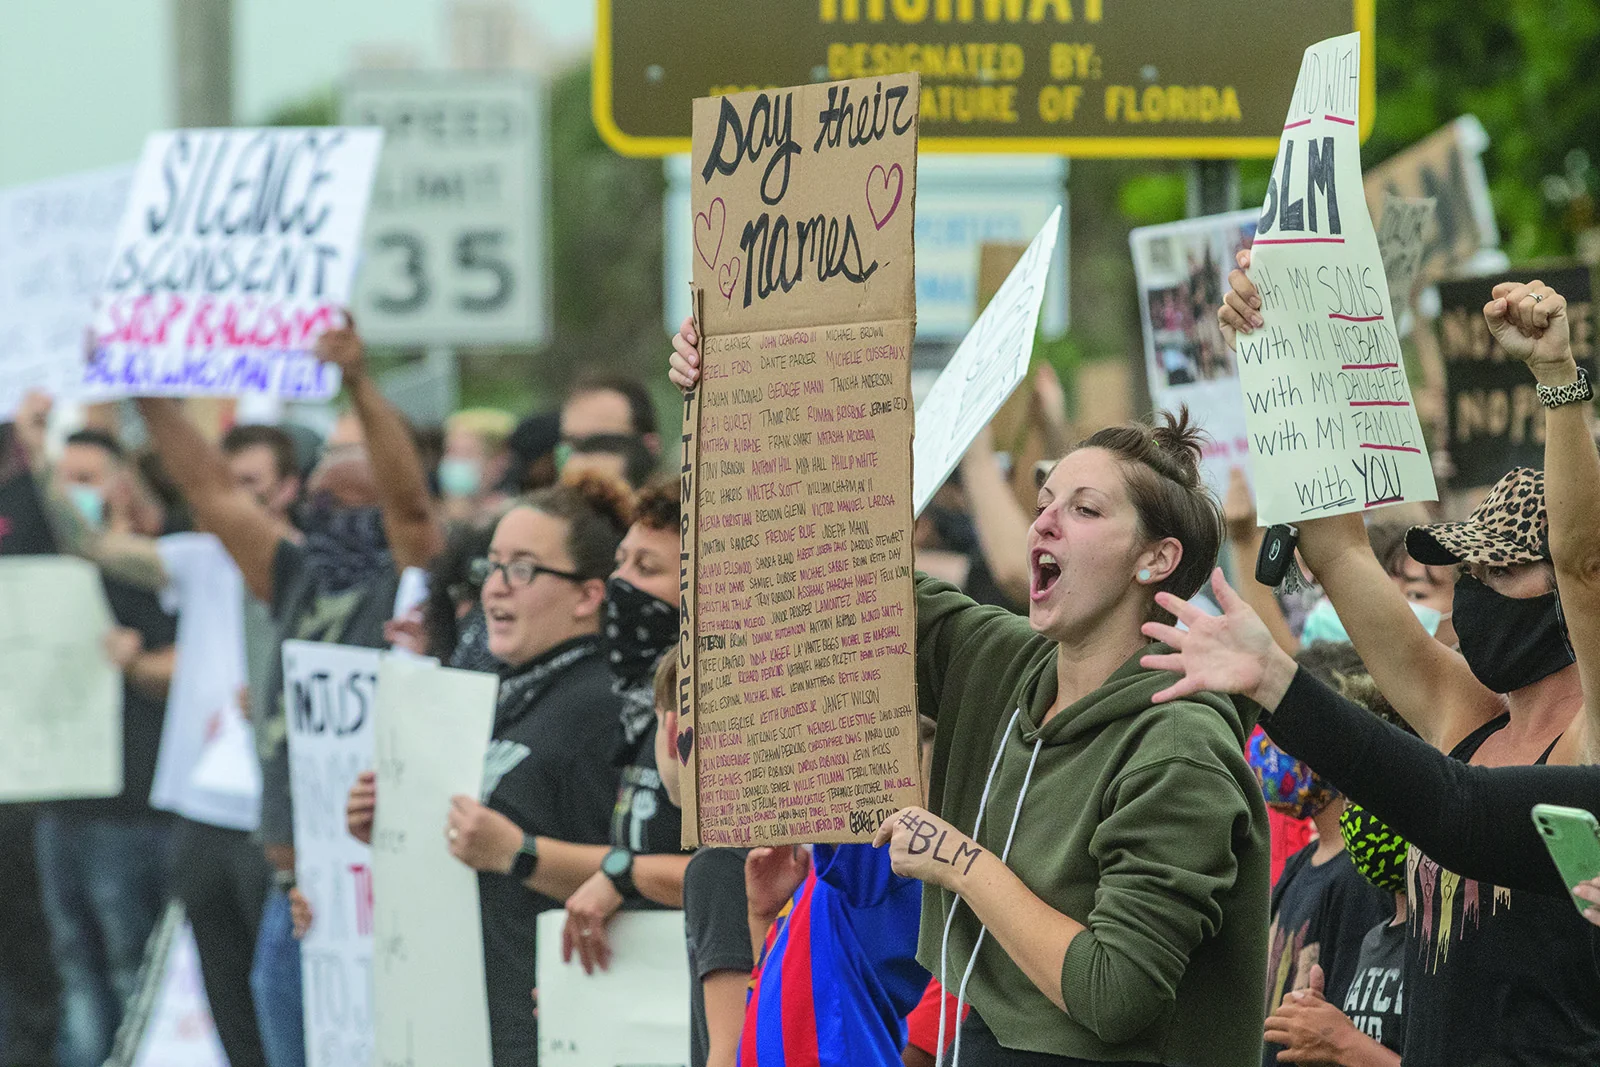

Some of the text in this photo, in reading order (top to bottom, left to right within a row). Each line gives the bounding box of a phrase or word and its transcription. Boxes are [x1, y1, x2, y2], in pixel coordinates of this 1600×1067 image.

[828, 43, 1024, 80] DESIGNATED
[813, 82, 913, 153] their
[1038, 86, 1083, 122] OF
[1104, 86, 1242, 122] FLORIDA
[147, 130, 344, 236] SILENCE
[371, 228, 517, 317] 35
[1257, 265, 1384, 317] ith MY SONS
[826, 328, 857, 341] MICHAEL
[859, 326, 885, 340] BROWN
[1240, 325, 1296, 365] with
[1298, 320, 1326, 361] MY
[1327, 320, 1399, 366] HUSBAND
[731, 360, 753, 375] FORD
[760, 354, 787, 370] DANTE
[788, 351, 817, 367] PARKER
[767, 381, 801, 400] GEORGE
[803, 379, 824, 395] MANN
[1246, 366, 1410, 414] with MY DAUGHTER
[723, 413, 752, 432] GURLEY
[785, 406, 800, 424] RICE
[1316, 412, 1346, 451] MY
[1351, 410, 1417, 448] FAMILY
[700, 461, 719, 481] TONY
[777, 456, 792, 473] HILL
[811, 456, 828, 472] HALL
[855, 451, 879, 468] WHITE
[1295, 453, 1403, 507] with YOU
[699, 487, 716, 508] ERIC
[747, 482, 777, 501] WALTER
[778, 480, 802, 497] SCOTT
[783, 503, 806, 519] GLENN
[812, 501, 835, 517] VICTOR
[730, 520, 870, 552] SANDERS FREDDIE BLUE JOSEPH MANN
[777, 551, 795, 566] BLAND
[875, 530, 905, 546] STEWART
[799, 565, 827, 581] MICHAEL
[888, 547, 902, 560] DAY
[855, 589, 878, 606] JONES
[880, 601, 905, 617] SMITH
[860, 668, 881, 681] JONES
[294, 672, 377, 735] NJUS
[822, 693, 850, 714] JANET
[850, 687, 881, 706] WILSON
[778, 724, 802, 740] SCOTT
[868, 760, 900, 777] THOMAS
[849, 809, 877, 836] GEORGE
[898, 810, 982, 876] #BLM
[1343, 967, 1404, 1014] ATC
